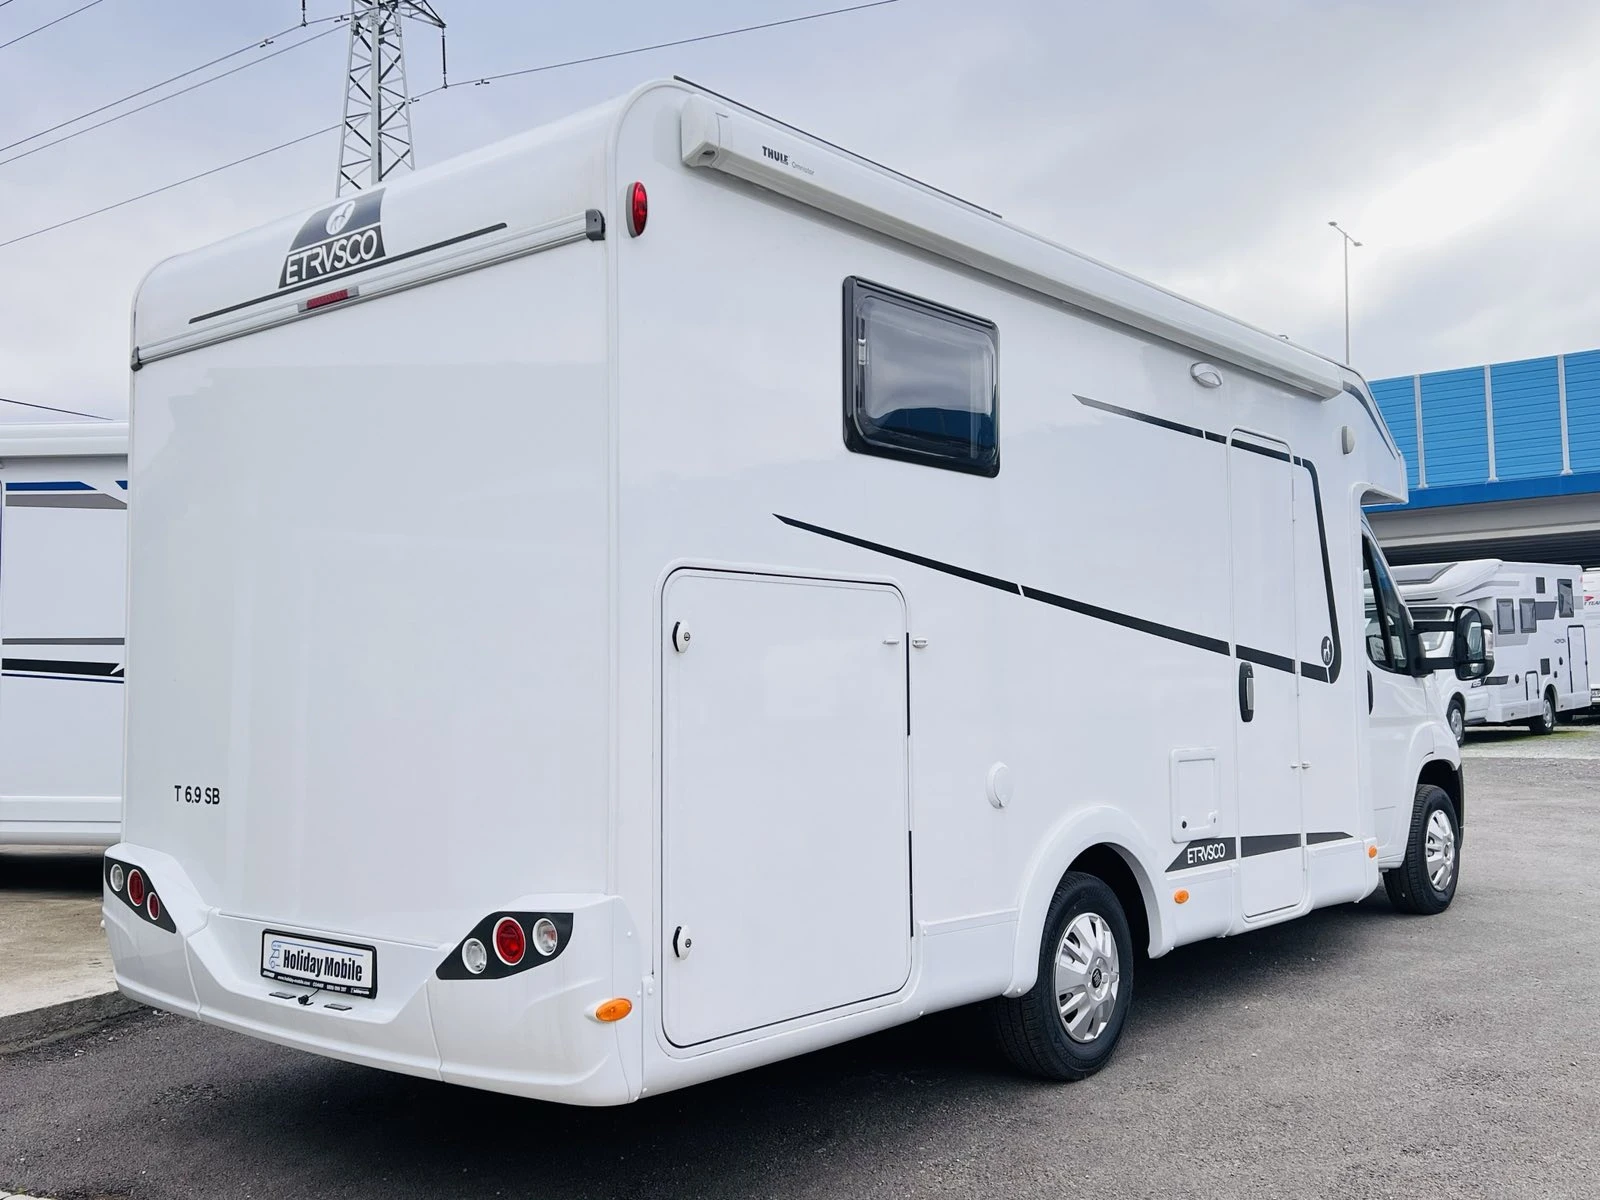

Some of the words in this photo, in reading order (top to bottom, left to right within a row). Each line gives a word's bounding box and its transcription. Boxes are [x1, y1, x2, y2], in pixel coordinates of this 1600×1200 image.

[762, 146, 789, 162] THULE
[174, 785, 182, 802] T
[185, 785, 202, 804] 6.9
[204, 787, 220, 805] SB
[283, 949, 323, 978] Holiday
[323, 956, 363, 982] Mobile
